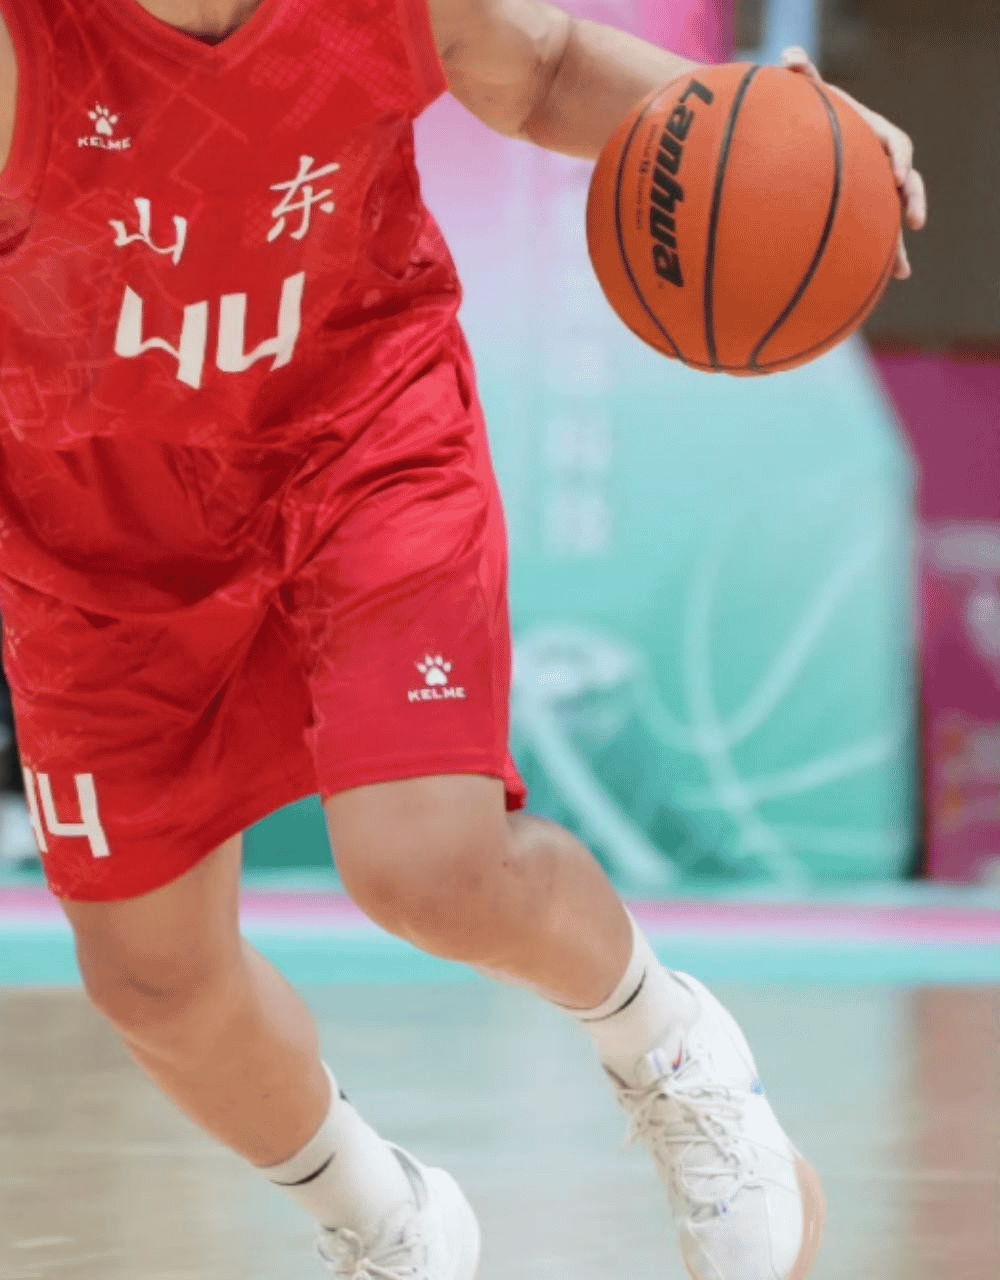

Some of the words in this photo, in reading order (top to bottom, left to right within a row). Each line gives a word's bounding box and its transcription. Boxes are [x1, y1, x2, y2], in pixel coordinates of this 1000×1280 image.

[77, 136, 132, 150] KELME
[649, 78, 716, 289] Lanhua
[108, 154, 341, 266] 山东
[114, 271, 306, 390] 44
[407, 686, 467, 702] KELME
